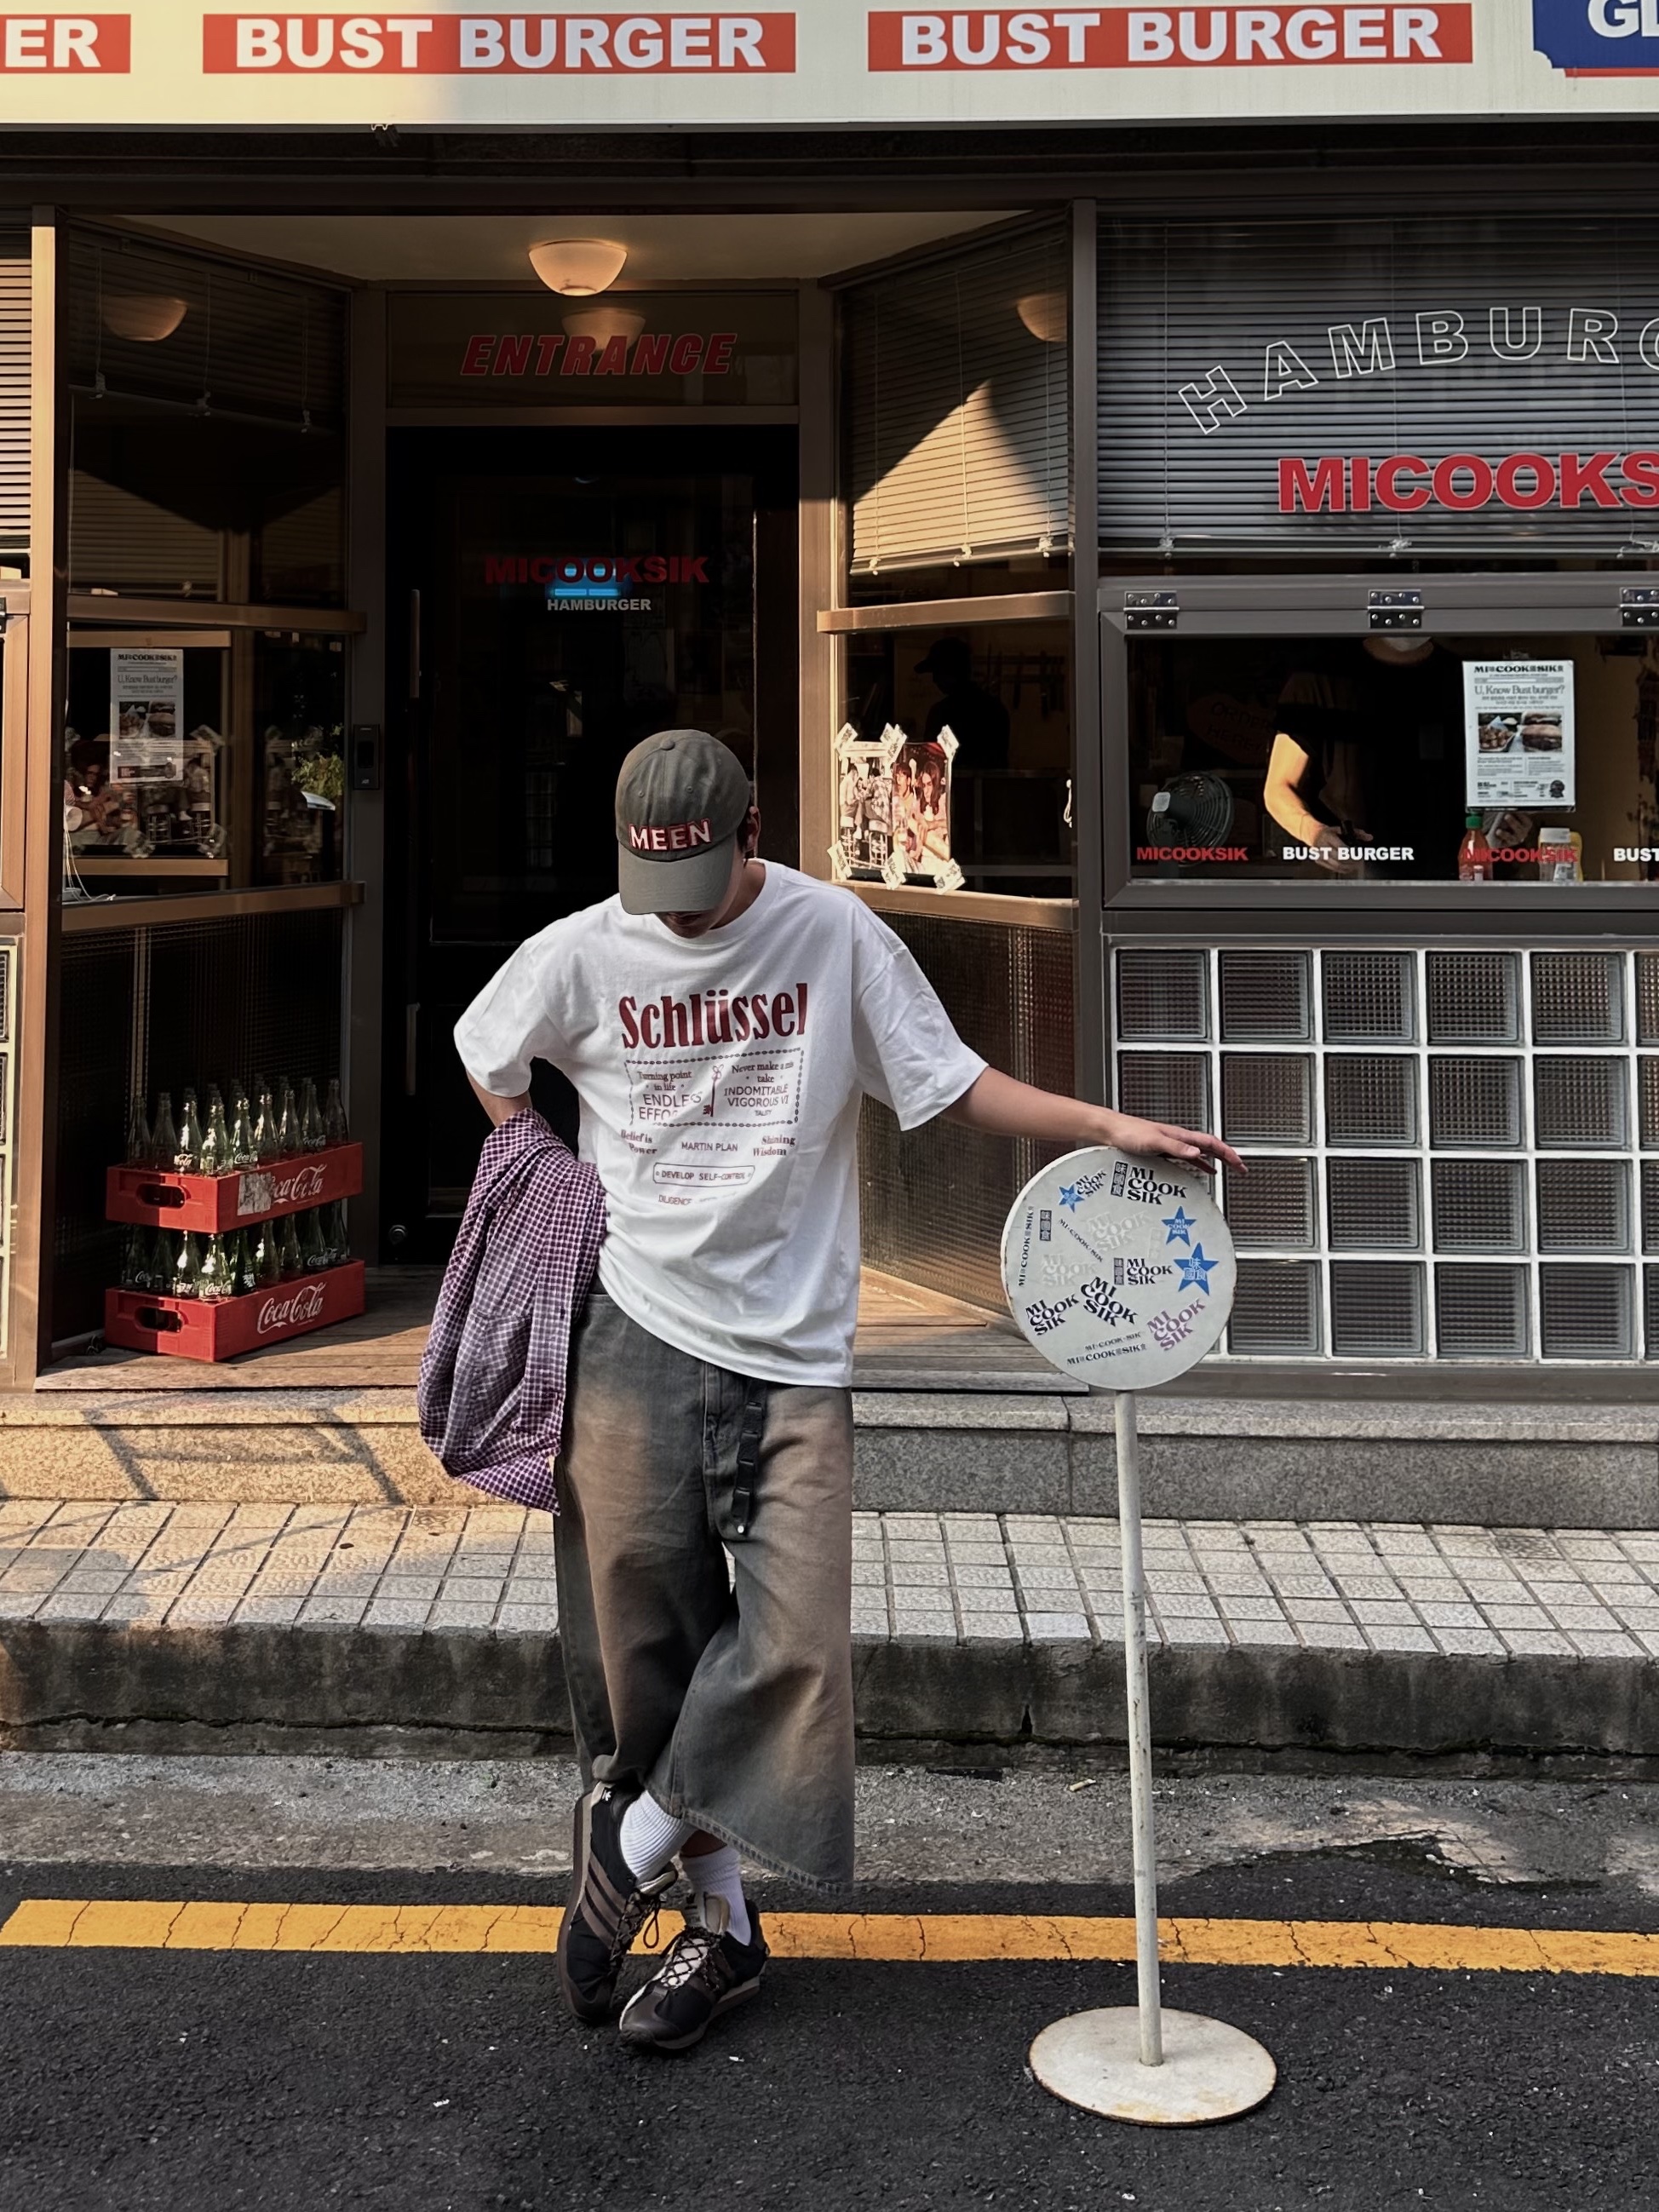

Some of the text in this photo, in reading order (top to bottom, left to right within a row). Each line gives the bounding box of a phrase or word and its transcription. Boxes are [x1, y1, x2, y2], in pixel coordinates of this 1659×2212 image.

[5, 19, 100, 68] ER
[236, 15, 765, 68] BUST BURGER
[901, 9, 1443, 66] BUST BURGER
[460, 333, 738, 376] ENTRANCE
[1277, 451, 1659, 513] MICOOKS
[483, 555, 709, 584] MICOOKSIK
[546, 598, 652, 612] HAMBURGER
[1486, 685, 1511, 694] Know
[1513, 685, 1531, 694] Bust
[1532, 685, 1565, 696] burger?
[629, 818, 712, 852] MEEN
[1136, 847, 1249, 862] MICOOKSIK
[1283, 846, 1415, 862] BUST BURGER
[1465, 847, 1579, 864] MICOOKSIK
[1613, 847, 1659, 862] BUST
[618, 983, 808, 1049] Schlüssel
[732, 1064, 755, 1073] Never
[757, 1061, 779, 1071] make
[637, 1071, 692, 1083] Turning point
[757, 1073, 775, 1083] take
[664, 1082, 676, 1091] life
[724, 1083, 789, 1097] INDOMITABLE
[727, 1097, 779, 1107] VIGOROUS
[620, 1129, 652, 1144] Belief is
[761, 1135, 796, 1146] Shining
[629, 1143, 657, 1155] Power
[681, 1141, 738, 1152] MARTIN PLAN
[753, 1147, 787, 1157] Wisdom
[661, 1170, 694, 1180] DEVELOP
[1076, 1175, 1090, 1186] MI
[1130, 1166, 1154, 1181] MI
[1076, 1170, 1107, 1195] COOK
[1128, 1177, 1188, 1199] COOK
[1127, 1188, 1162, 1205] SIK
[1127, 1258, 1145, 1267] MI
[1127, 1266, 1174, 1277] COOK
[1089, 1276, 1117, 1298] MI
[1128, 1275, 1157, 1286] SIK
[257, 1282, 328, 1335] Coca-Cola
[1025, 1299, 1048, 1319] MI
[1030, 1293, 1080, 1326] COOK
[1080, 1284, 1139, 1325] COOK
[1083, 1299, 1120, 1328] SIK
[1153, 1297, 1206, 1342] COOK
[1034, 1313, 1066, 1336] SIK
[1147, 1310, 1171, 1334] MI
[1159, 1322, 1194, 1352] SIK
